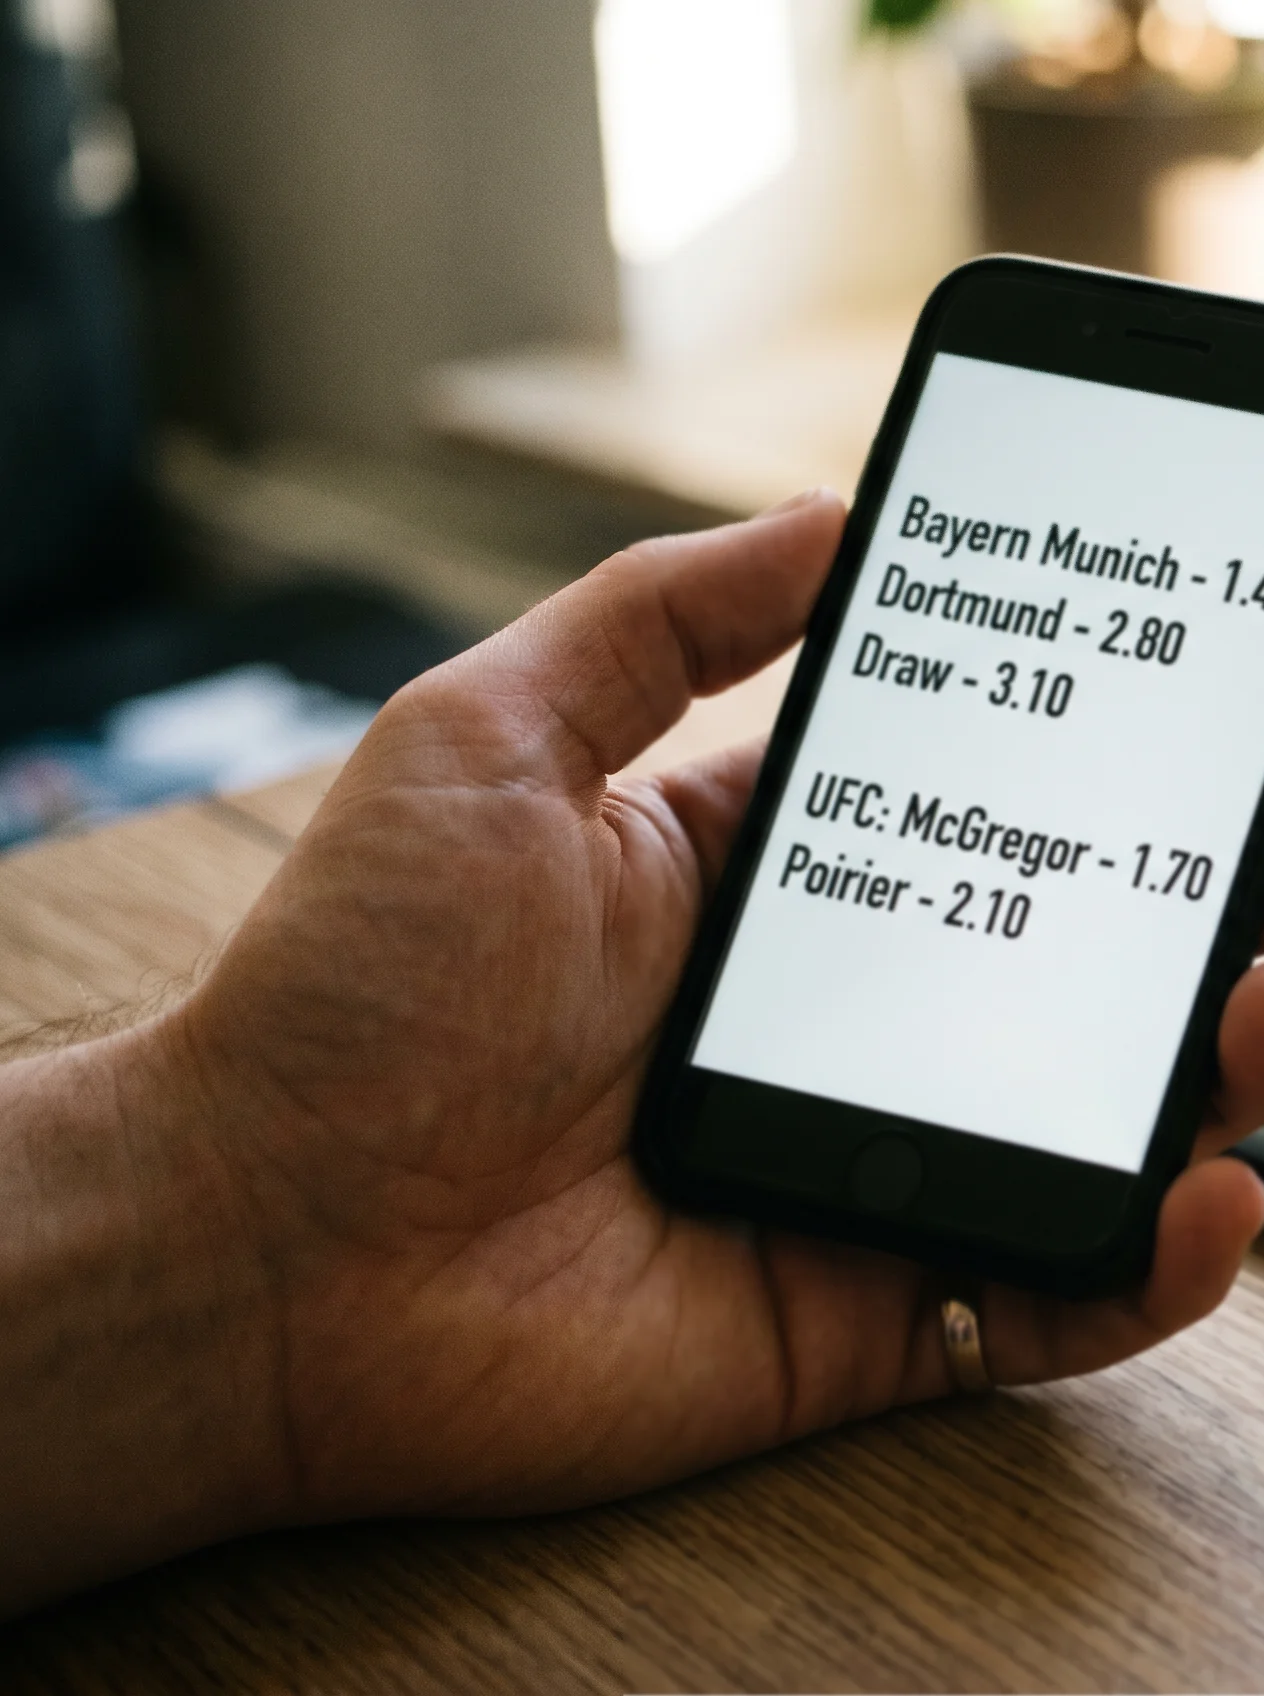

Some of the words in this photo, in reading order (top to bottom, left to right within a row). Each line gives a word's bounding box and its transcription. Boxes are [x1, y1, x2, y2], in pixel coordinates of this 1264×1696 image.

[898, 493, 1032, 562] Bayern
[1038, 522, 1181, 592] Munich
[875, 562, 1068, 643] Dortmund
[1097, 608, 1187, 667] 2.80
[851, 631, 955, 694] Draw
[987, 660, 1075, 719] 3.10
[804, 771, 891, 833] UFC:
[897, 792, 1092, 879] McGregor
[1131, 842, 1214, 902] 1.70
[778, 842, 912, 913] Poirier
[942, 880, 1032, 940] 2.10
